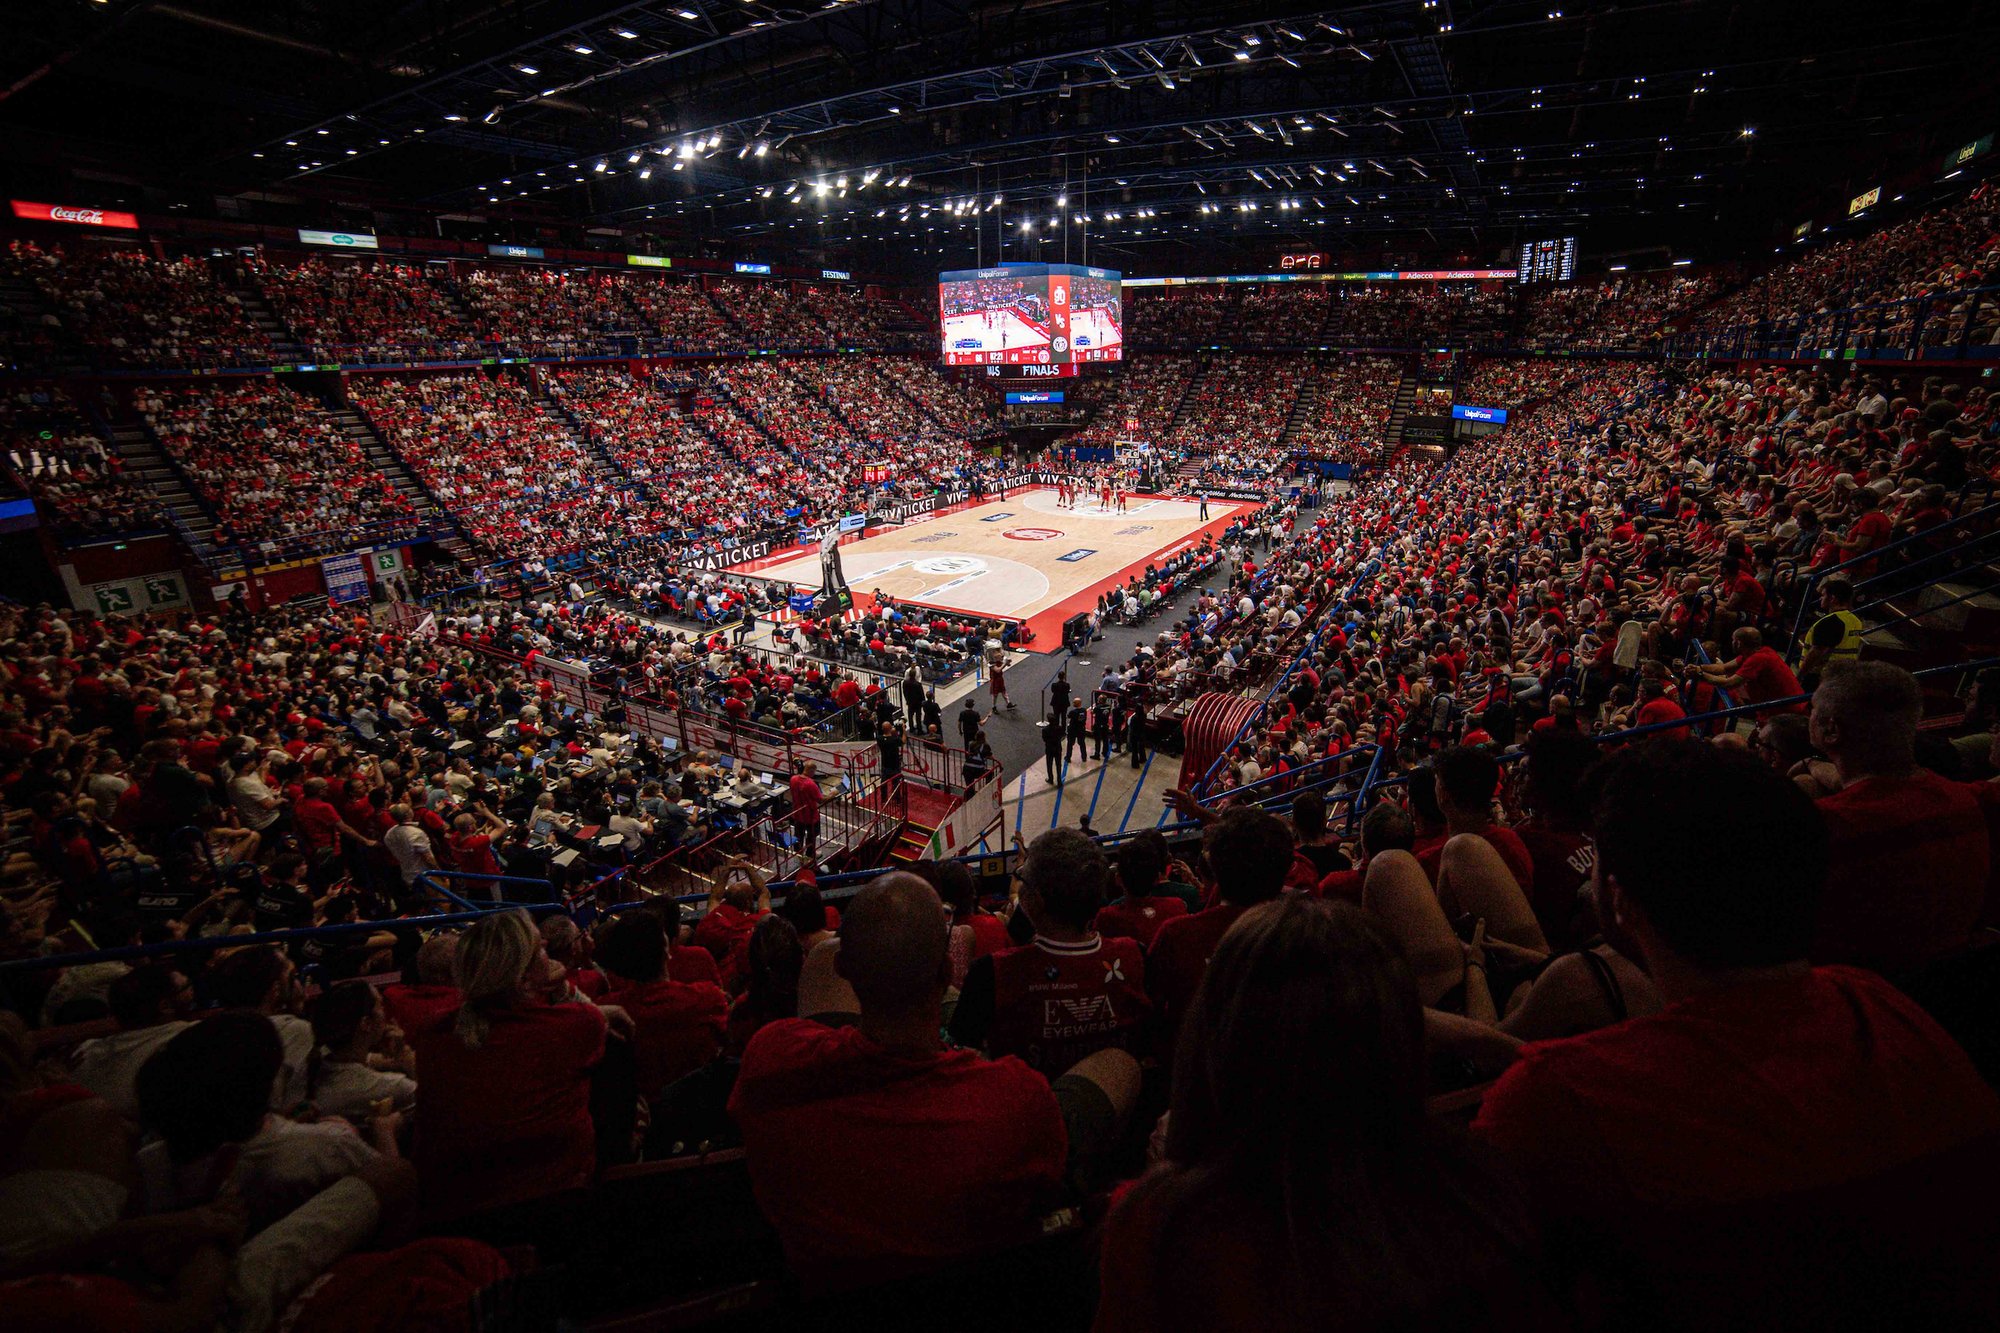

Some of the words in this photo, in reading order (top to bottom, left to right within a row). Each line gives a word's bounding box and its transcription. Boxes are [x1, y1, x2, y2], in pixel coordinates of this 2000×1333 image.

[50, 206, 104, 224] Coca-Cola
[977, 269, 1009, 279] UnipolForum
[1406, 272, 1434, 280] Adecco
[1446, 271, 1475, 279] Adecco
[1022, 364, 1060, 376] FINALS
[1042, 1020, 1119, 1039] EYEWEAR
